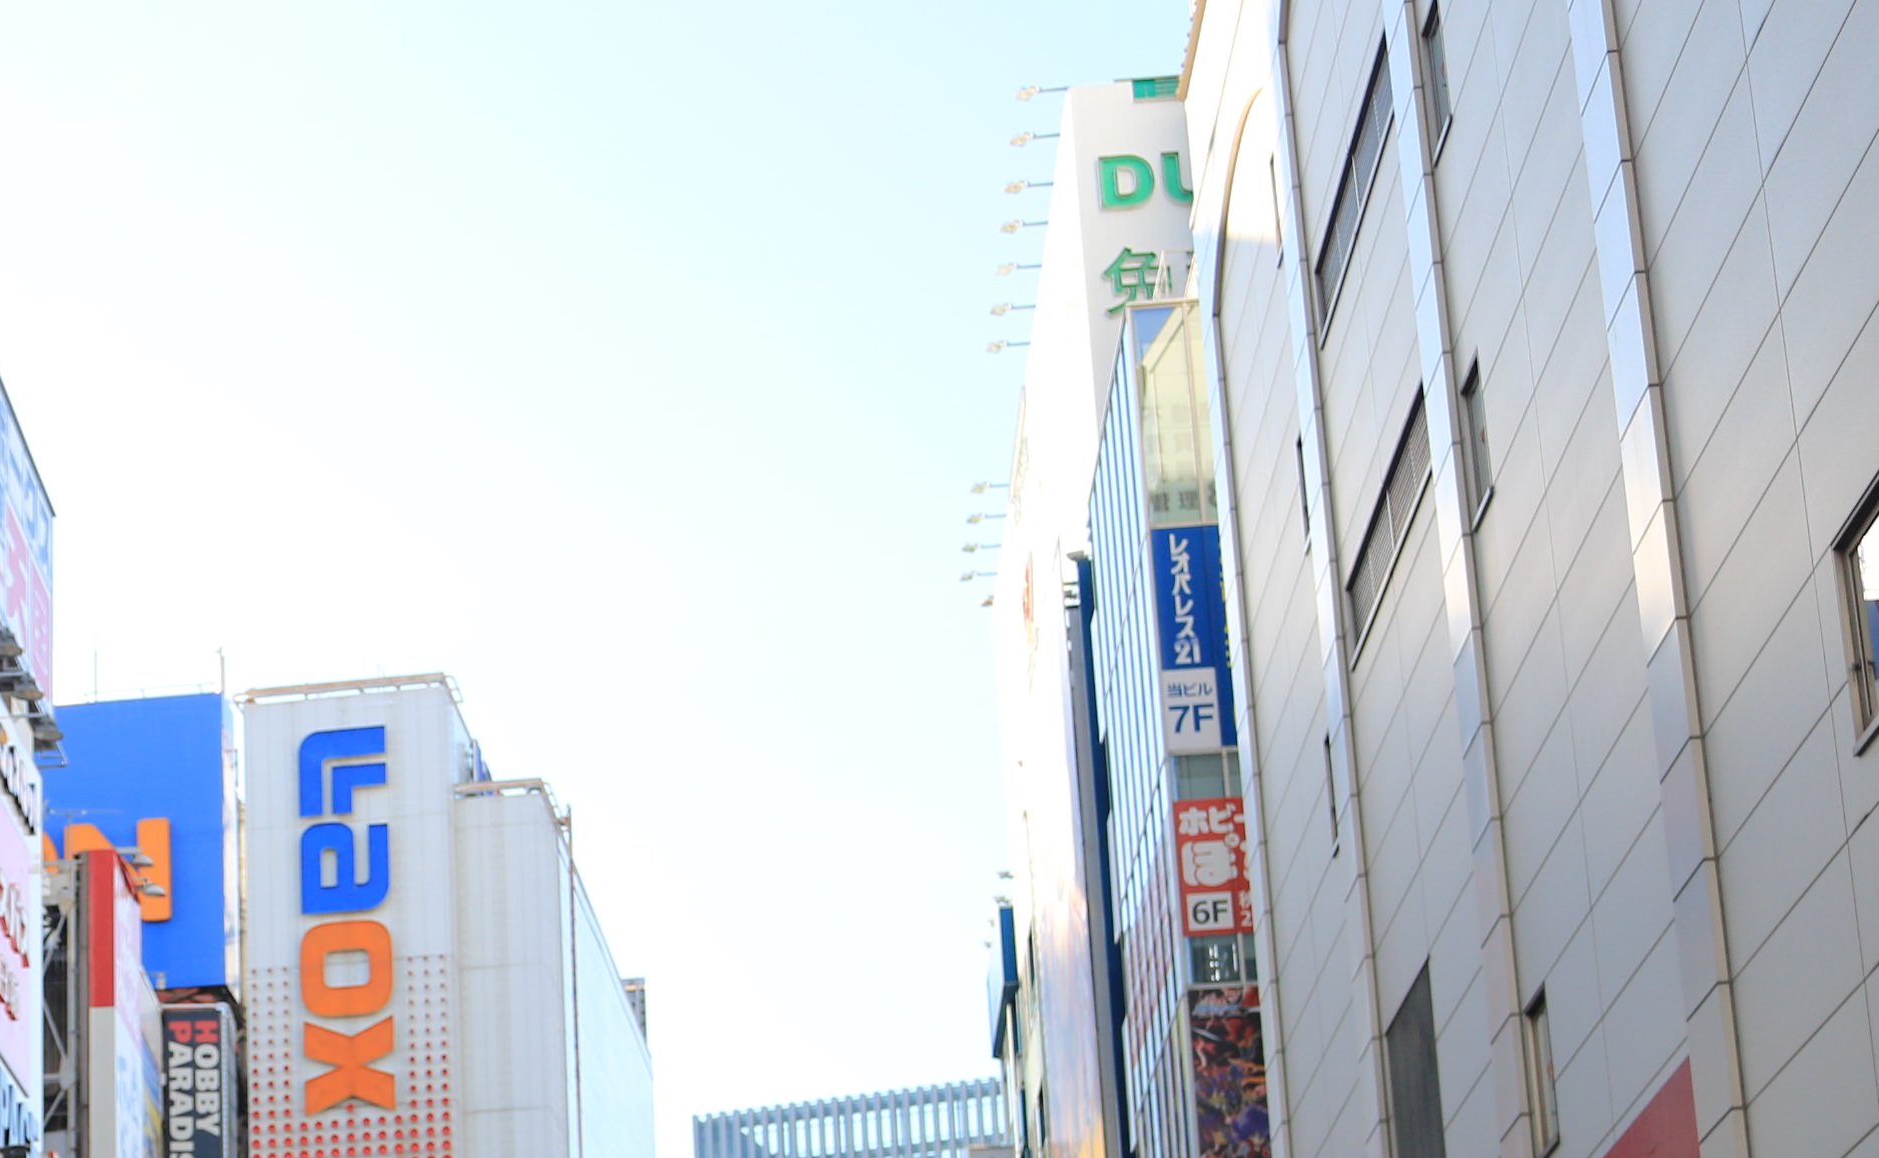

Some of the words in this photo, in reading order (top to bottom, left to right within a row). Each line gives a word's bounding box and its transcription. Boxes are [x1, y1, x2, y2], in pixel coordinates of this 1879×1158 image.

[1168, 533, 1202, 665] レオパレス21
[1166, 682, 1214, 699] 当ビル
[1168, 703, 1216, 734] 7F
[1191, 900, 1229, 926] 6F
[193, 1019, 221, 1136] HOBBY
